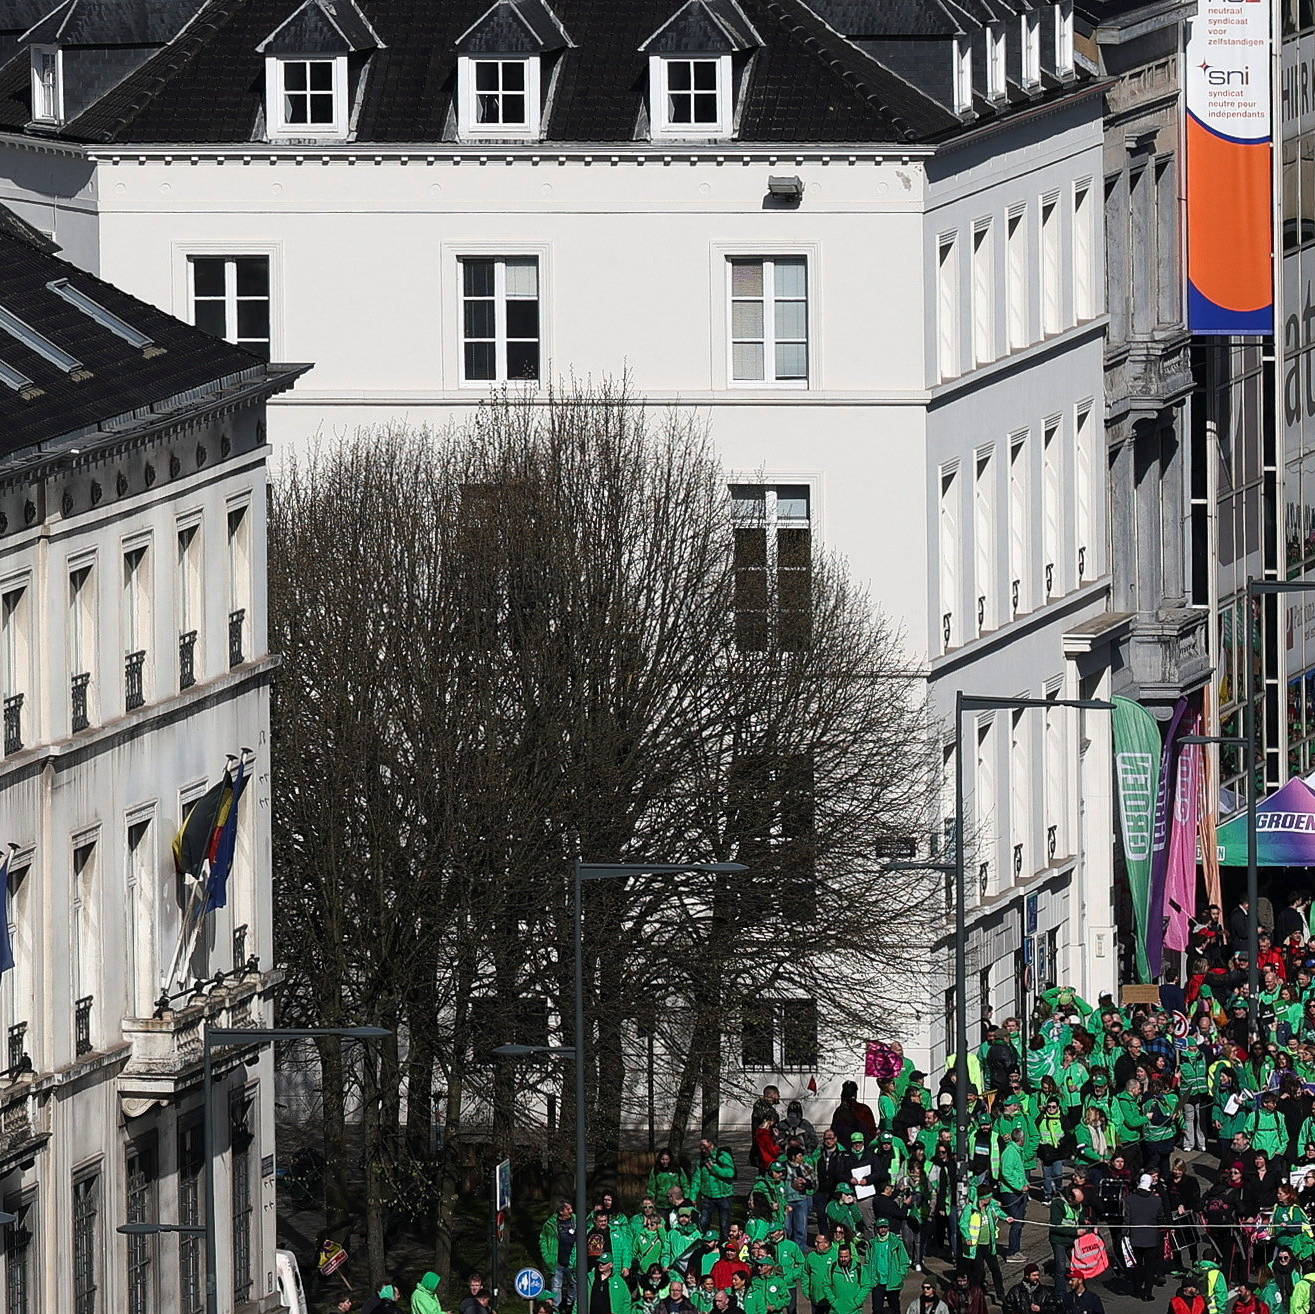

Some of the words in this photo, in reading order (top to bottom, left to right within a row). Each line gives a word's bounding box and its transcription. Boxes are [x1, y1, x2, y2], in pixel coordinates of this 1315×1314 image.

[1208, 7, 1243, 15] neutraal
[1208, 17, 1248, 25] syndicaat
[1208, 38, 1264, 46] zelfstandigen
[1208, 66, 1249, 85] sni
[1208, 90, 1244, 98] syndicat
[1208, 110, 1265, 119] indépendants
